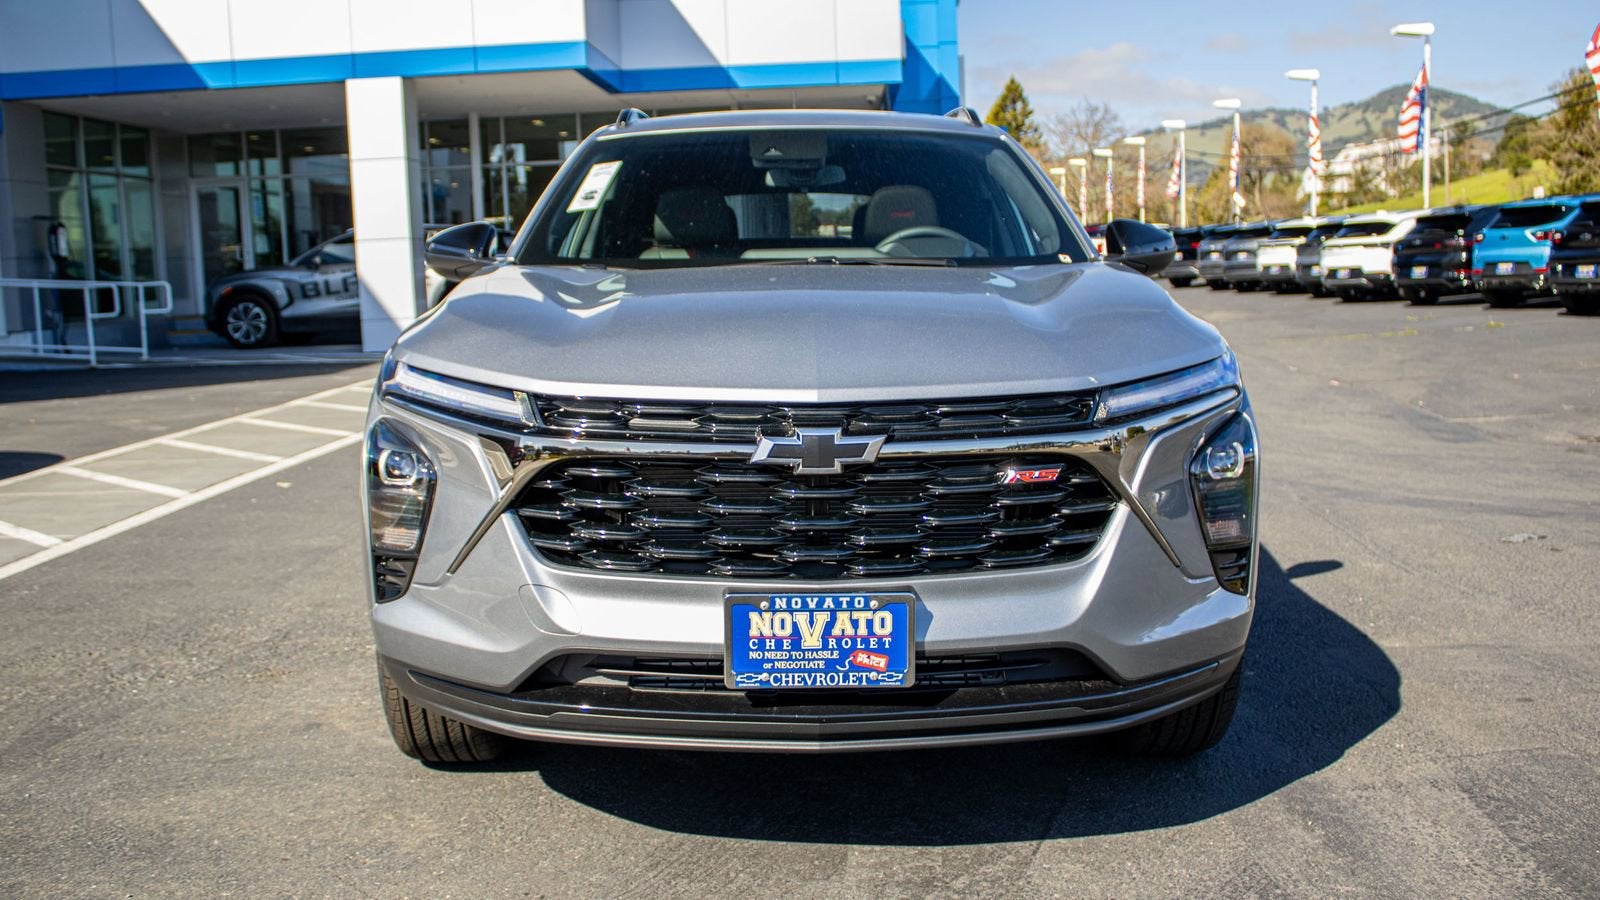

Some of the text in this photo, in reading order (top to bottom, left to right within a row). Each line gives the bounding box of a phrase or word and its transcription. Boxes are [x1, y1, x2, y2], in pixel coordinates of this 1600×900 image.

[1003, 467, 1061, 483] RS
[775, 597, 865, 609] NOVATO
[749, 610, 893, 649] NOVATO
[749, 650, 839, 660] NO NEED TO HASSLE
[774, 660, 825, 669] NEGOTIATE
[769, 672, 870, 686] CHEVROLET
